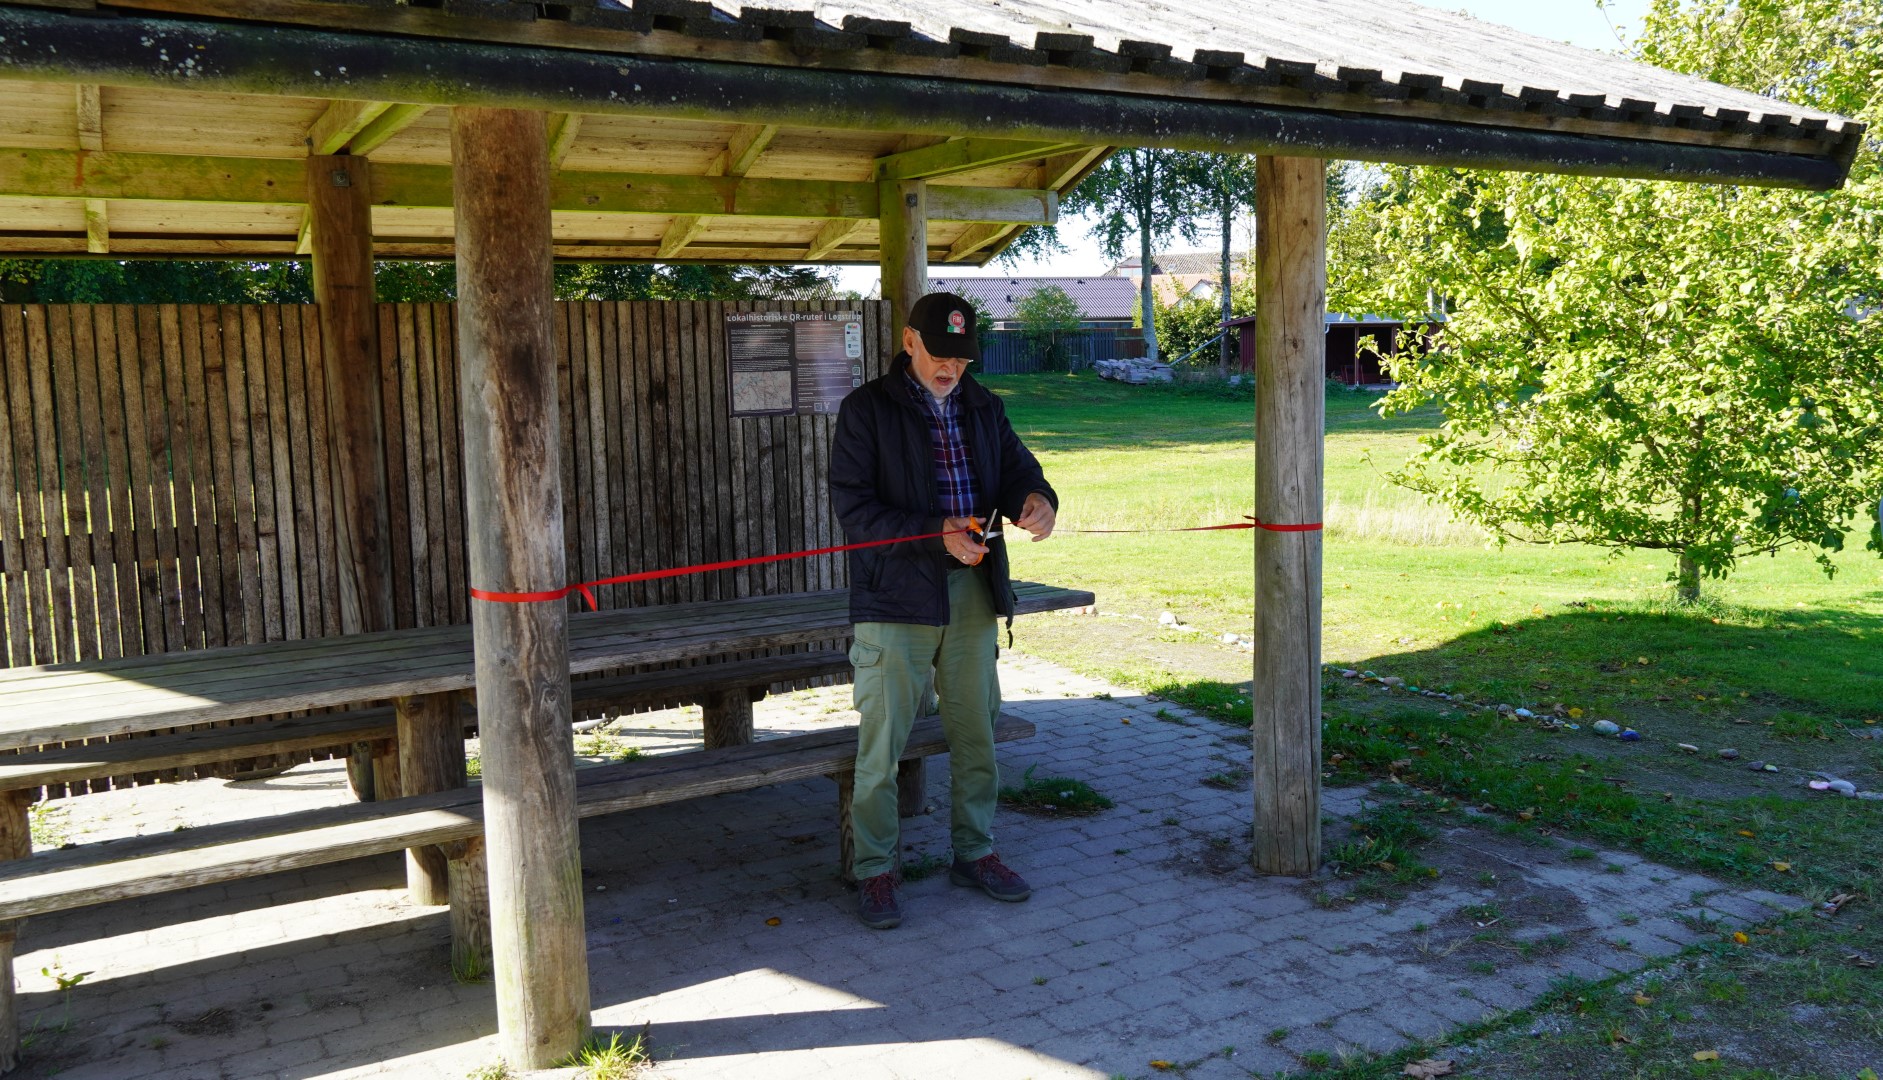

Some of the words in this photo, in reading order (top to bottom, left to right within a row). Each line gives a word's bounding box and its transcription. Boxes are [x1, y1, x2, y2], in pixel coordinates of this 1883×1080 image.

[726, 314, 788, 322] Lokalhistoriske
[790, 313, 823, 322] QR-ruter
[828, 313, 861, 322] Løgstrup
